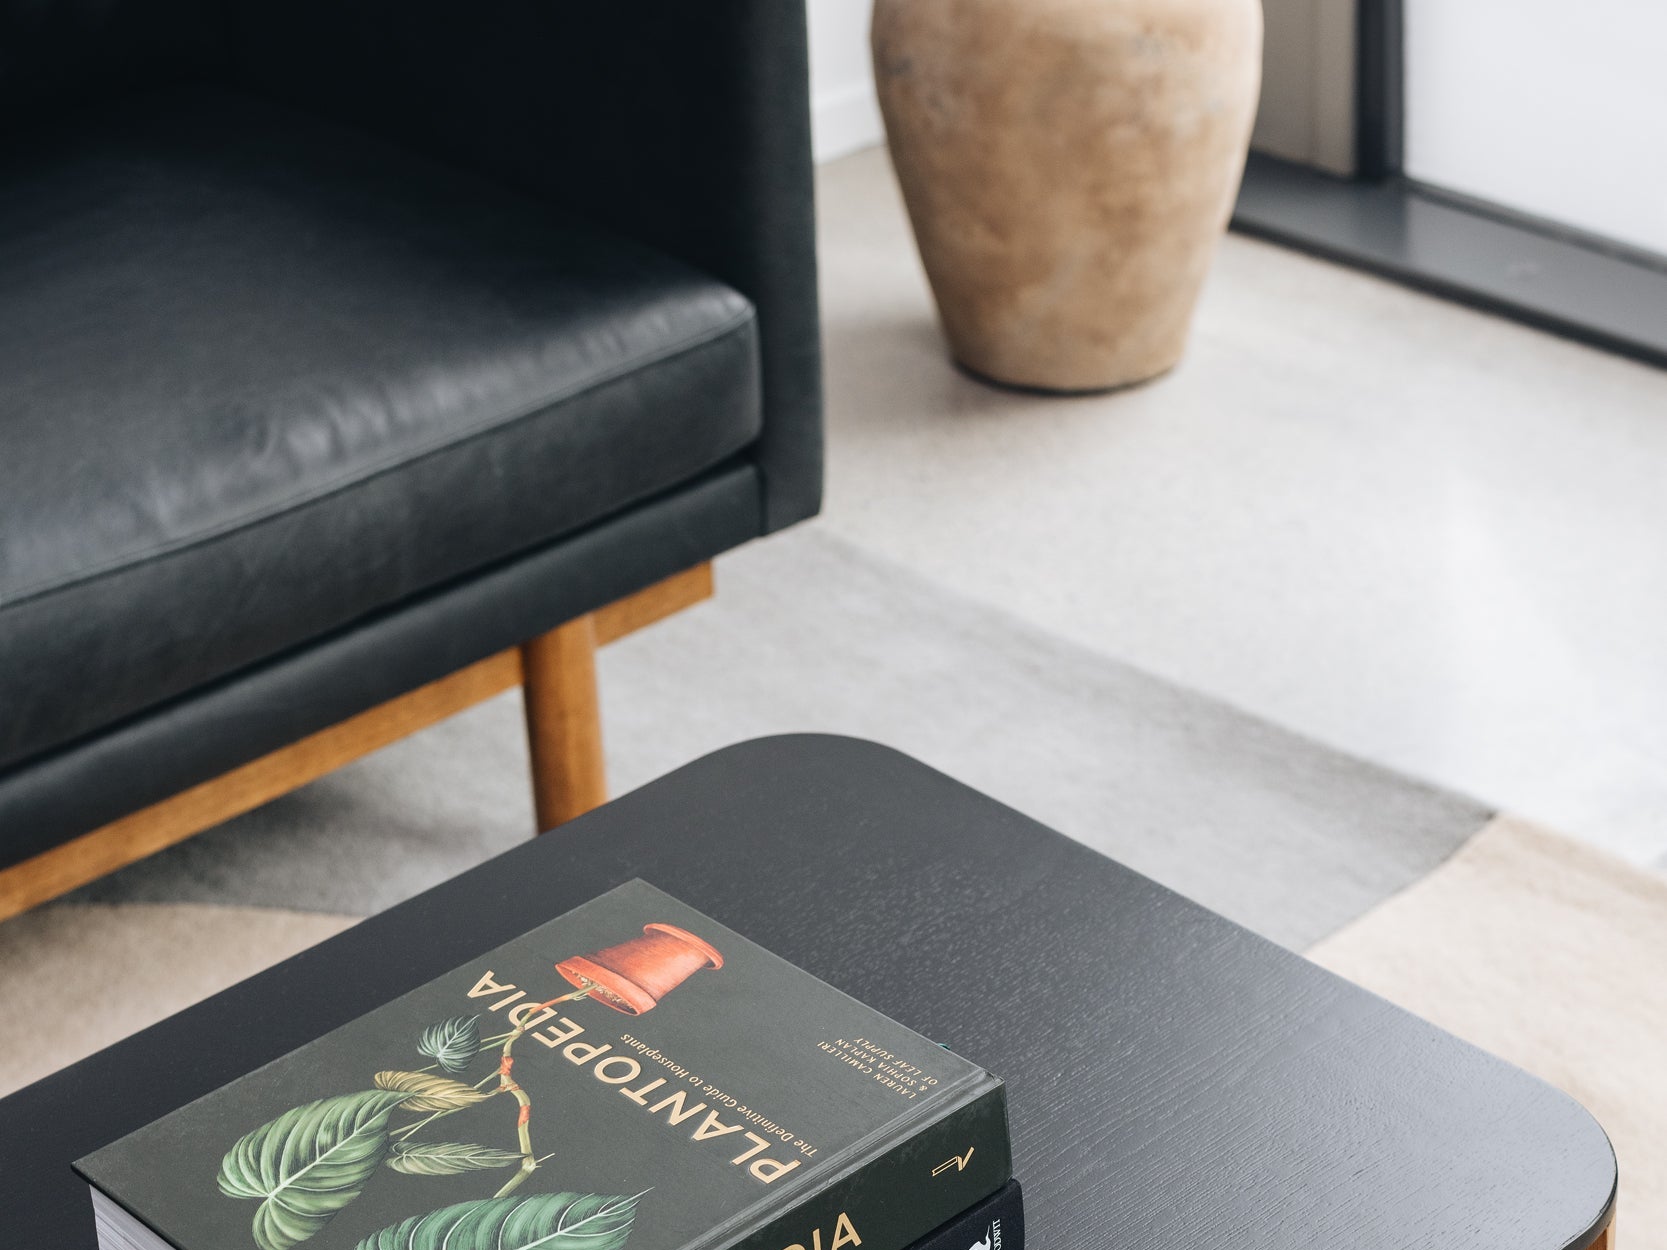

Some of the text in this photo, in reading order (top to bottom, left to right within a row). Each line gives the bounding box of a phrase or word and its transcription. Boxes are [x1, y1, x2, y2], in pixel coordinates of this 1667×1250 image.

[467, 969, 802, 1185] PLANTOPEDIA
[817, 1041, 917, 1099] LAUREN CAMILLERI
[834, 1038, 876, 1063] KAPLAN
[853, 1037, 938, 1086] OF LEAF SUPPLY
[877, 1061, 917, 1086] SOPHIA
[620, 1033, 818, 1158] The Definitive Guide to Houseplants
